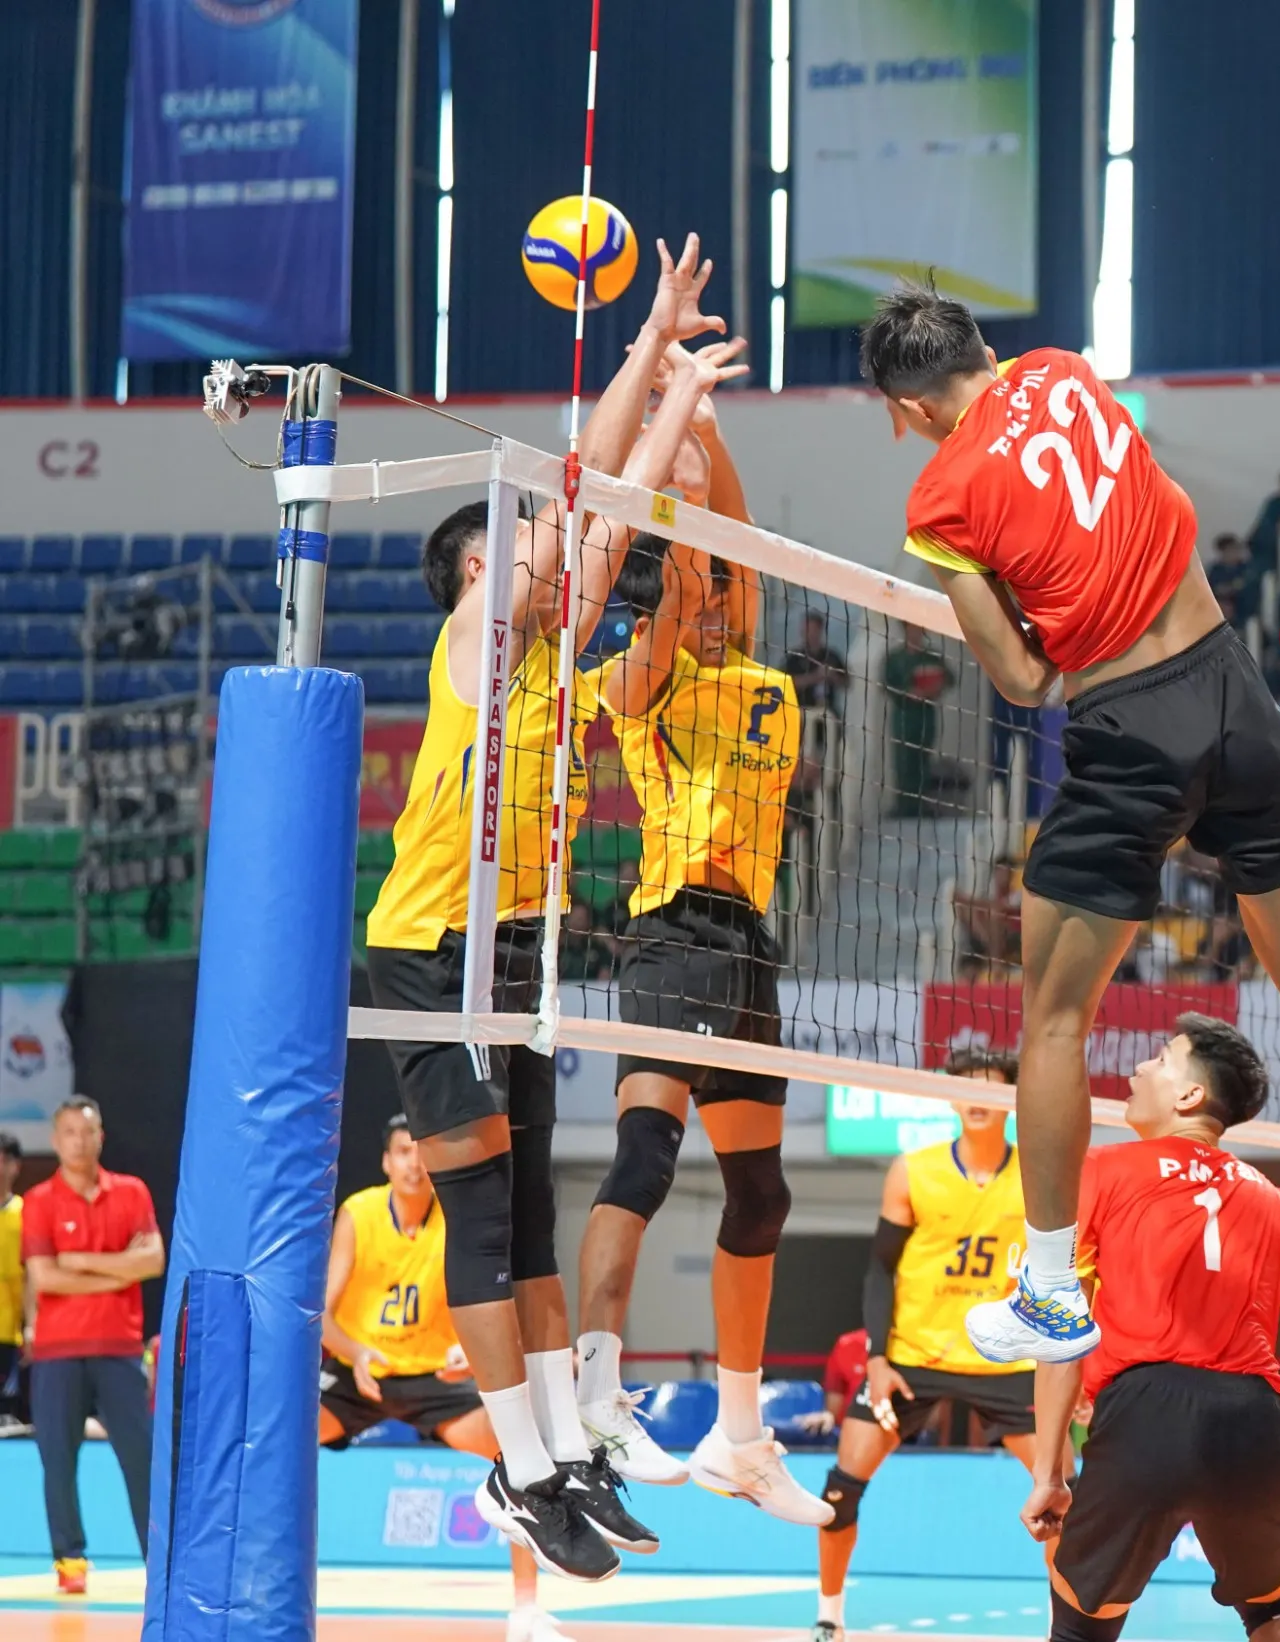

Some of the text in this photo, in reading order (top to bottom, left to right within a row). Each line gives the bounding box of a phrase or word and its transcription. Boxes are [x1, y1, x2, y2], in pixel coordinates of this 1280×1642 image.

[38, 438, 101, 480] C2
[1021, 376, 1132, 532] 22
[746, 686, 783, 745] 2
[1193, 1187, 1223, 1272] 1
[945, 1235, 998, 1278] 35
[380, 1283, 419, 1326] 20
